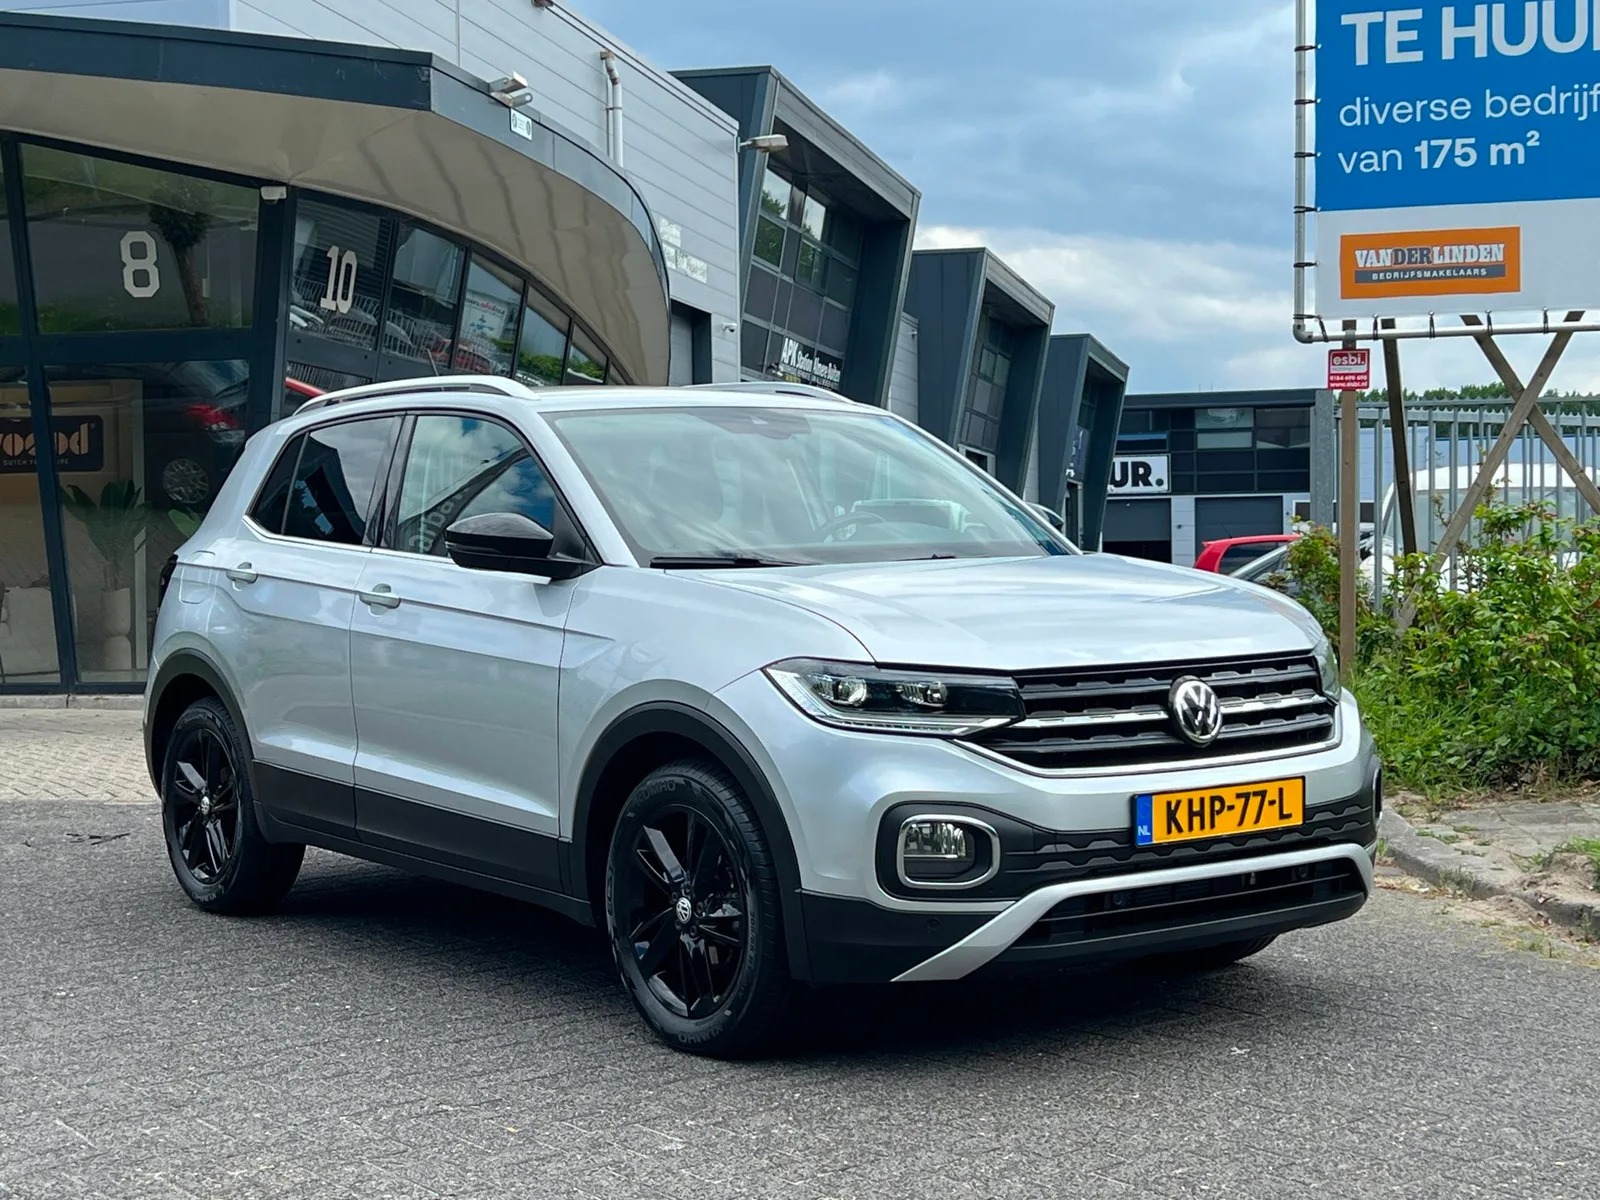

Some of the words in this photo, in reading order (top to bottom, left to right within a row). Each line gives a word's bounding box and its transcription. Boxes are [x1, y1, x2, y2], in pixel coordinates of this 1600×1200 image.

[1341, 9, 1423, 65] TE
[1339, 97, 1471, 126] diverse
[1338, 149, 1402, 173] van
[1415, 138, 1477, 169] 175
[120, 230, 160, 298] 8
[1372, 268, 1488, 280] BEDRIJFSMAKELAARS
[320, 245, 357, 314] 10
[781, 337, 799, 367] APK
[1333, 353, 1365, 365] esbi.
[633, 780, 676, 806] KUMHO
[1166, 787, 1293, 835] KHP-77-L
[1138, 825, 1151, 837] NL
